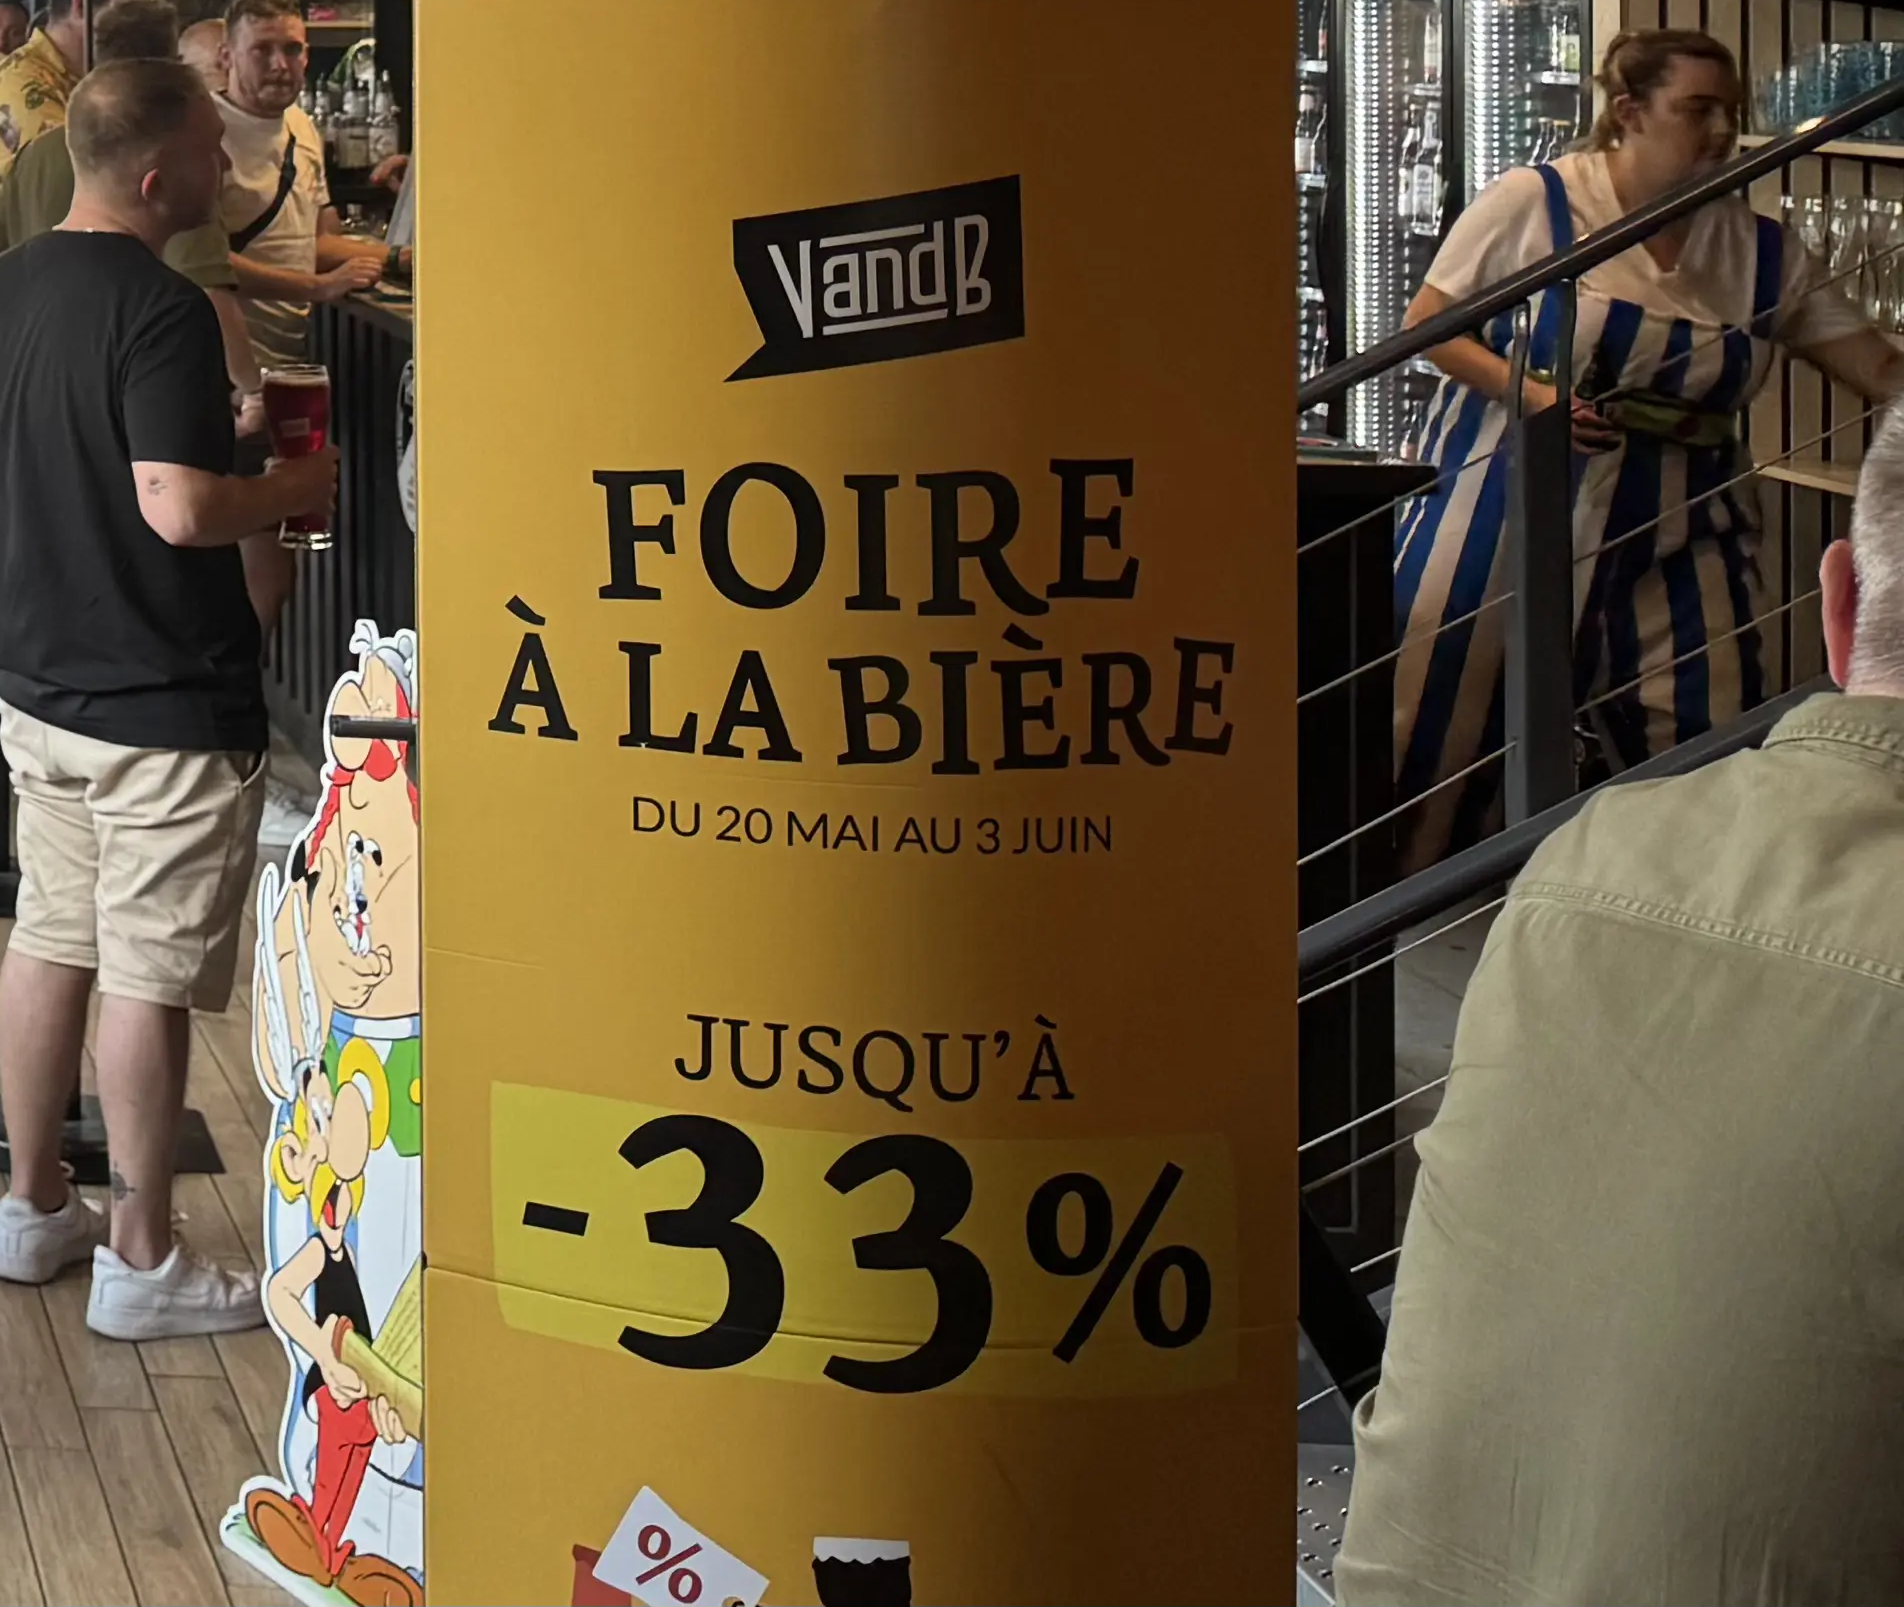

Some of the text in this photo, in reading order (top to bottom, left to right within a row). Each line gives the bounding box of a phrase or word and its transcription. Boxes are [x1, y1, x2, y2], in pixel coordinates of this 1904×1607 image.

[767, 213, 993, 338] VandB
[593, 457, 1140, 617] FOIRE
[488, 594, 1235, 775] À LA BIÈRE
[632, 795, 1113, 855] DU 20 MAI AU 3 JUIN
[674, 1014, 1075, 1112] JUSQU'À
